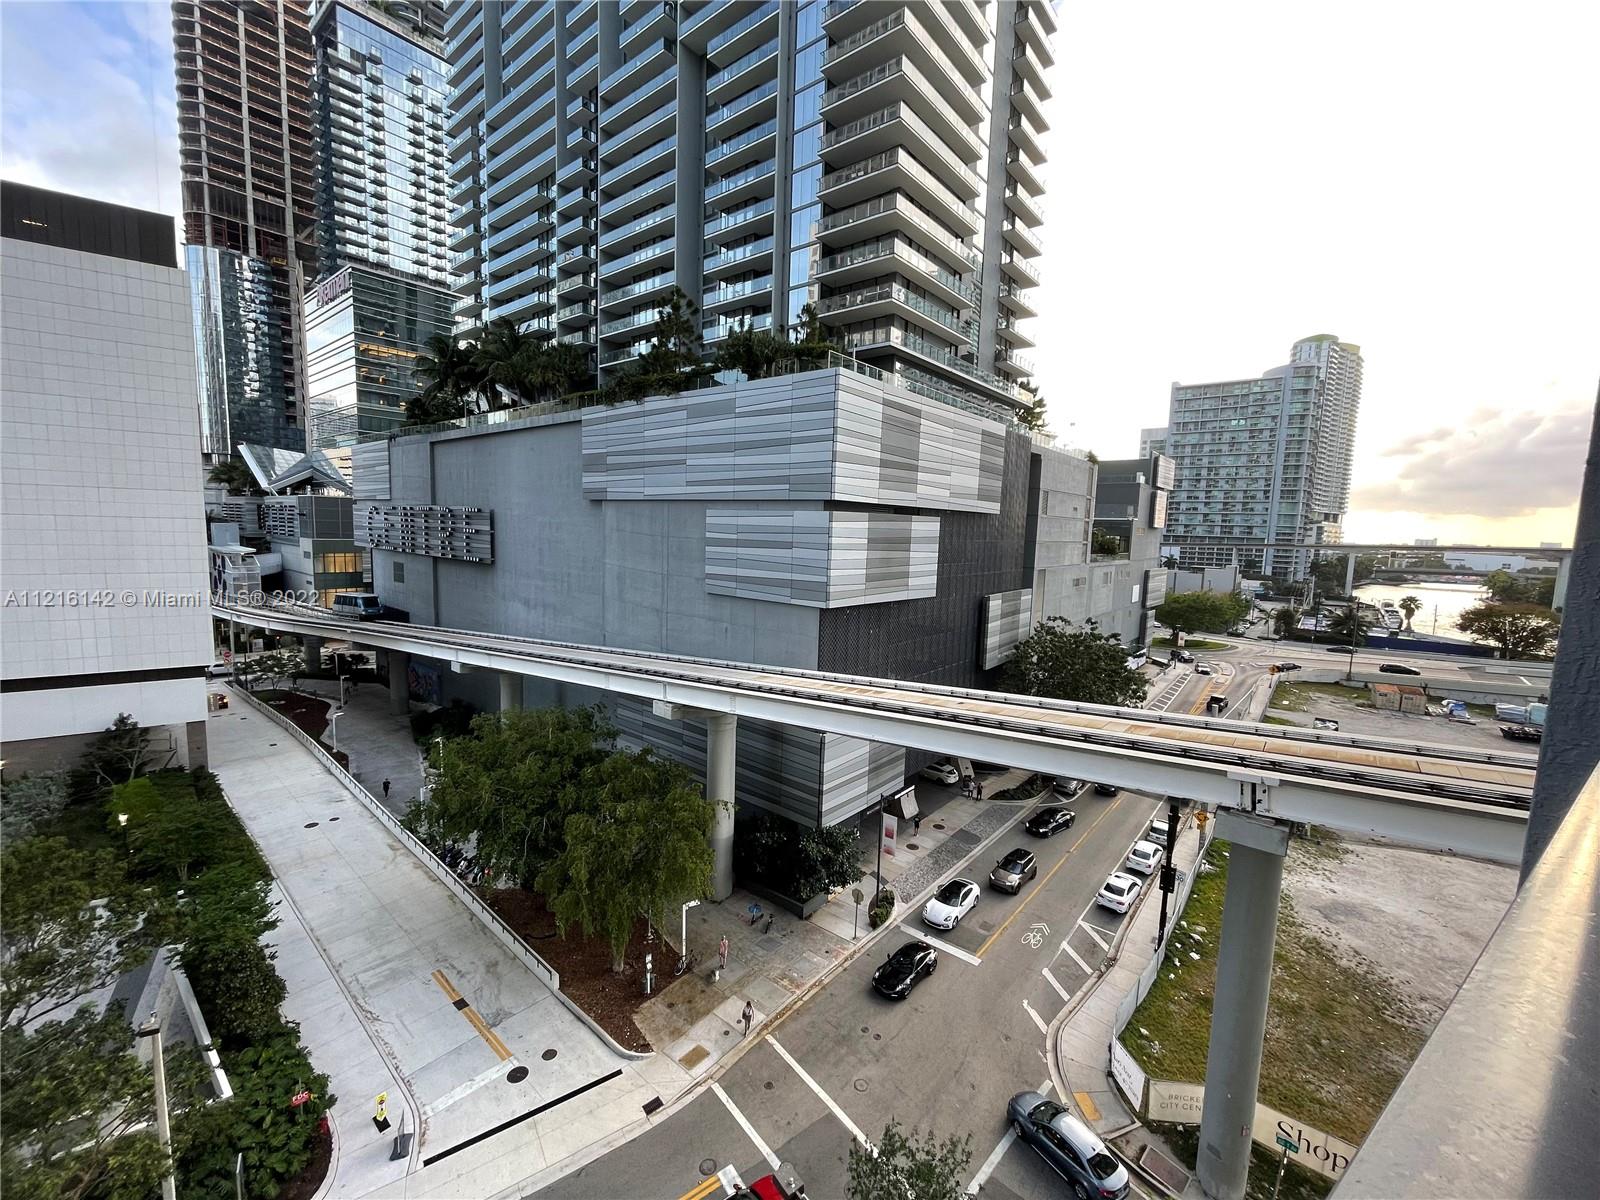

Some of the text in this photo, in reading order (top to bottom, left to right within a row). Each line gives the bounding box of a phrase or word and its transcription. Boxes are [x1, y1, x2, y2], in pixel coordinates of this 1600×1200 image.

[367, 505, 481, 563] CENTRE
[1159, 1102, 1201, 1112] CITY CEN
[1168, 1093, 1201, 1103] BRICKE
[1277, 1120, 1349, 1172] Shop
